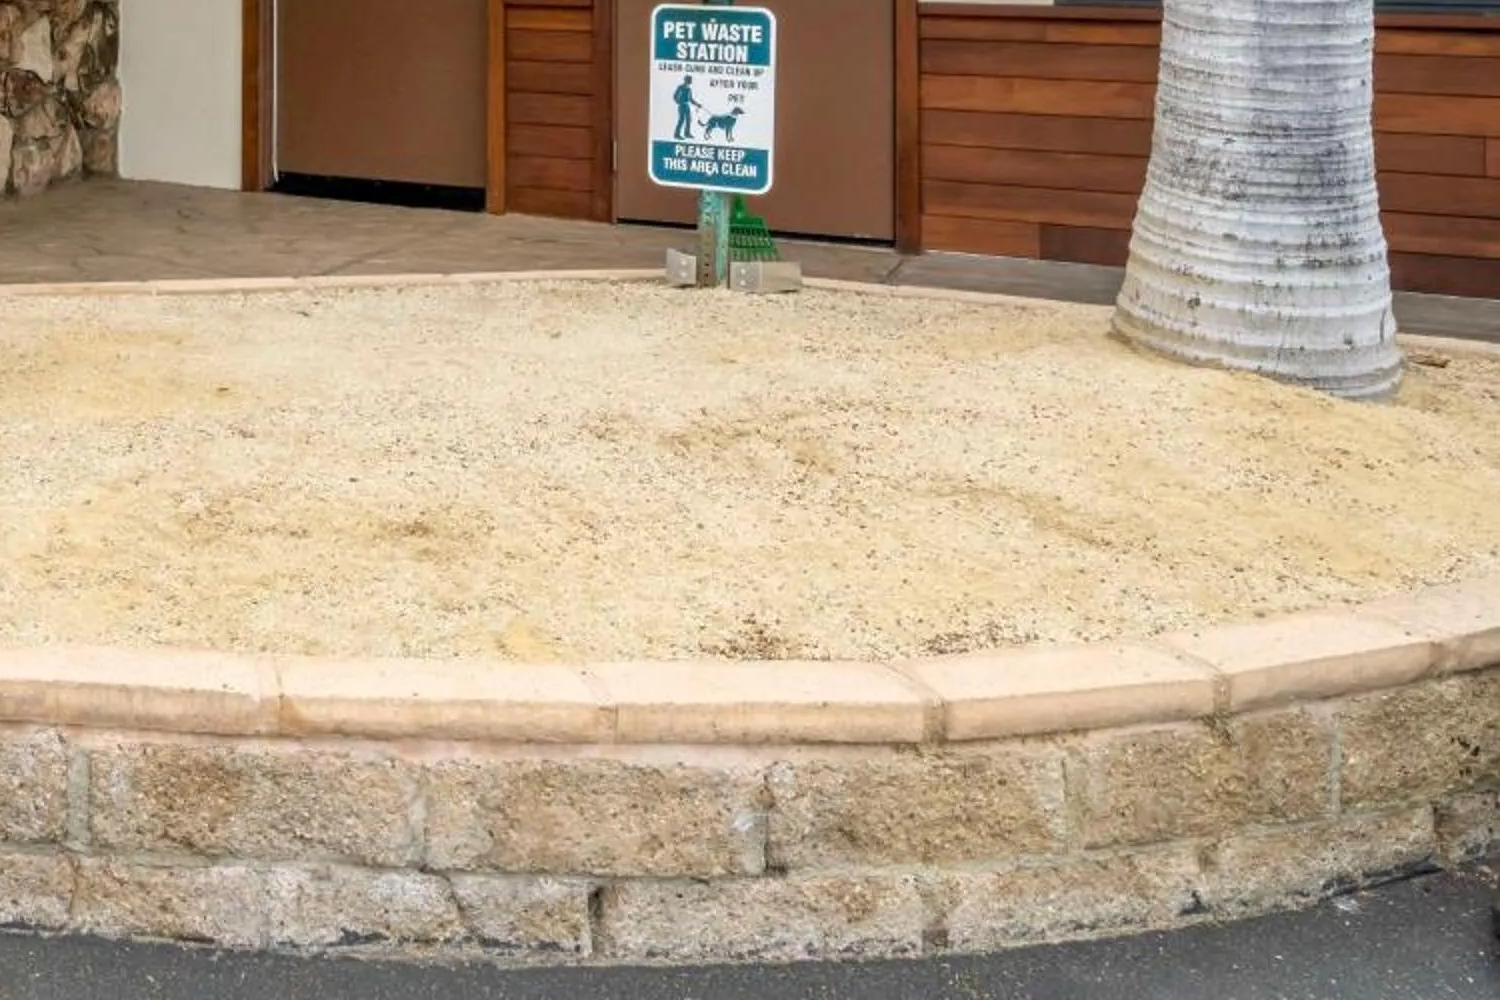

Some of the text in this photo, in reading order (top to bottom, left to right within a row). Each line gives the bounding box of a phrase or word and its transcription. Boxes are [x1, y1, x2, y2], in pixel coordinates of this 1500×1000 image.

[663, 21, 763, 43] PET WASTE
[676, 42, 748, 63] STATION
[708, 65, 724, 75] AND
[726, 67, 751, 77] CLEAN
[709, 79, 734, 89] AFTER
[728, 93, 745, 104] PET
[675, 144, 745, 162] PLEASE KEEP
[663, 157, 757, 178] THIS AREA CLEAN
